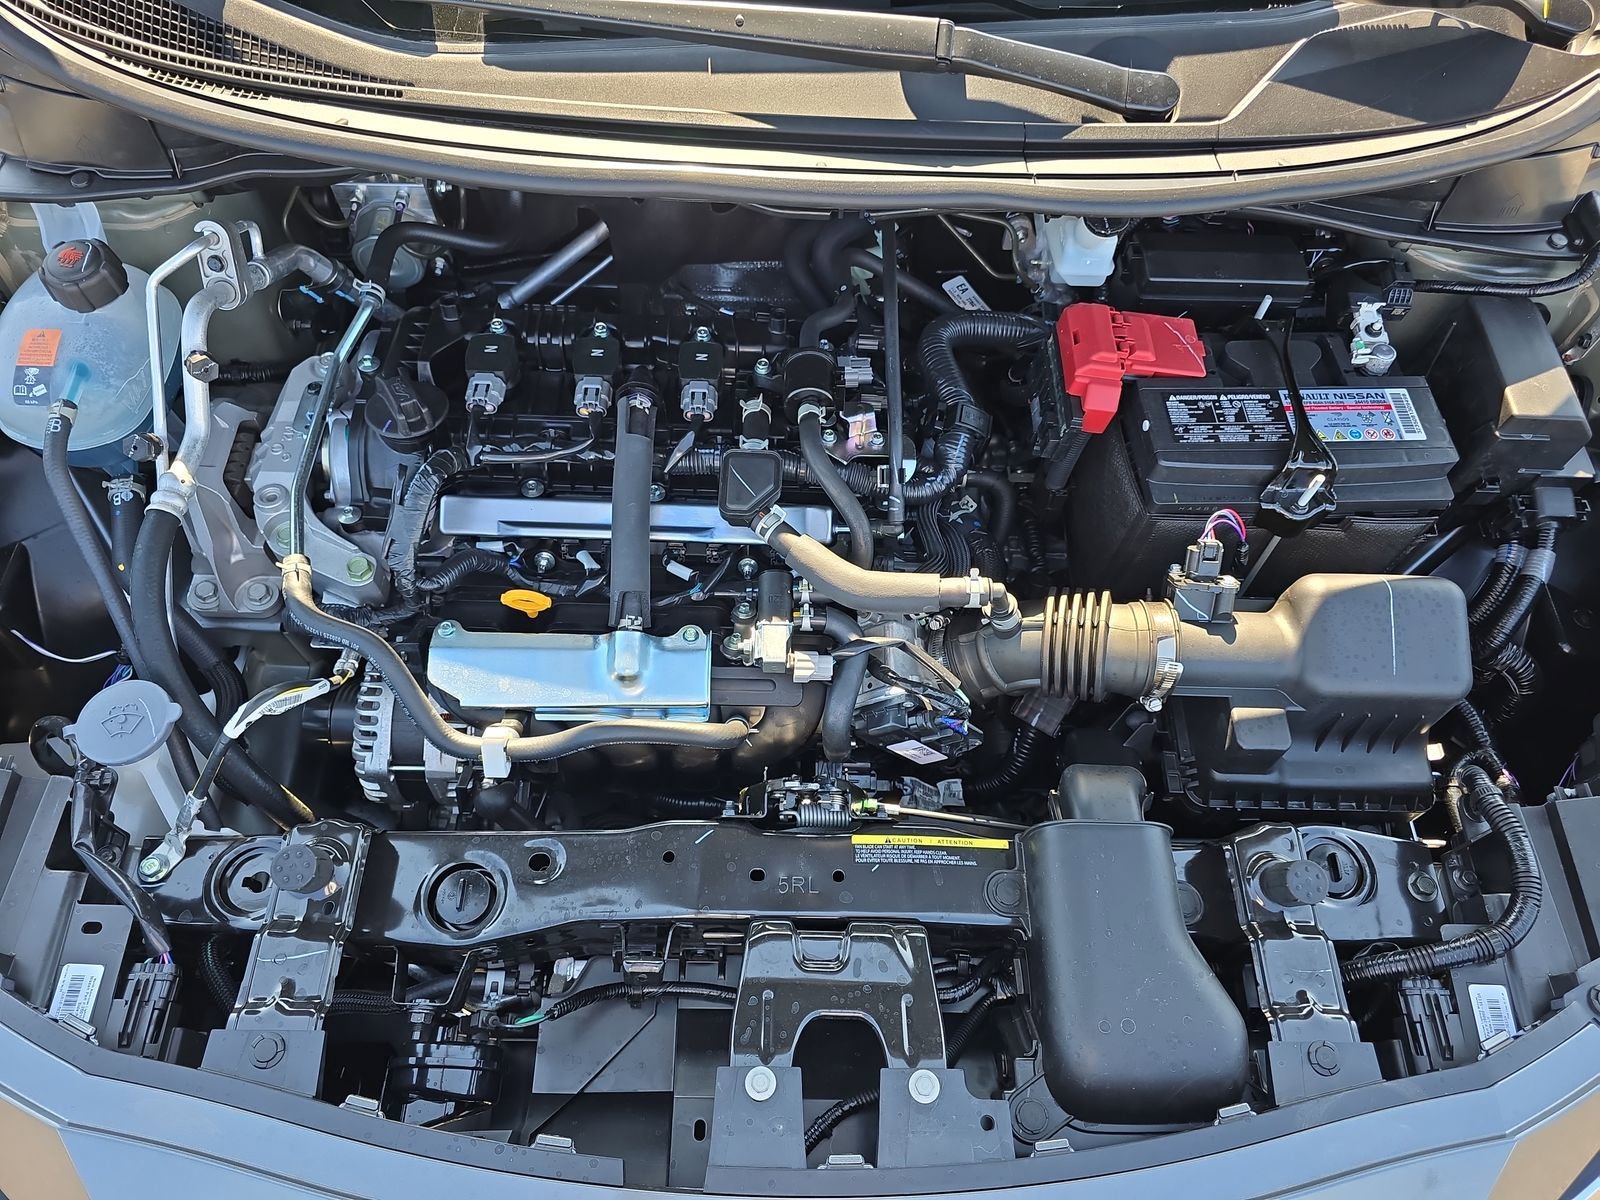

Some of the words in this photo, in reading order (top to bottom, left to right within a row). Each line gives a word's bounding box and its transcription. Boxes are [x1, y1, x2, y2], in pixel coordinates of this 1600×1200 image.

[956, 283, 969, 295] EA
[1333, 392, 1386, 400] NISSAN
[50, 418, 62, 432] B
[778, 876, 820, 894] 5RL
